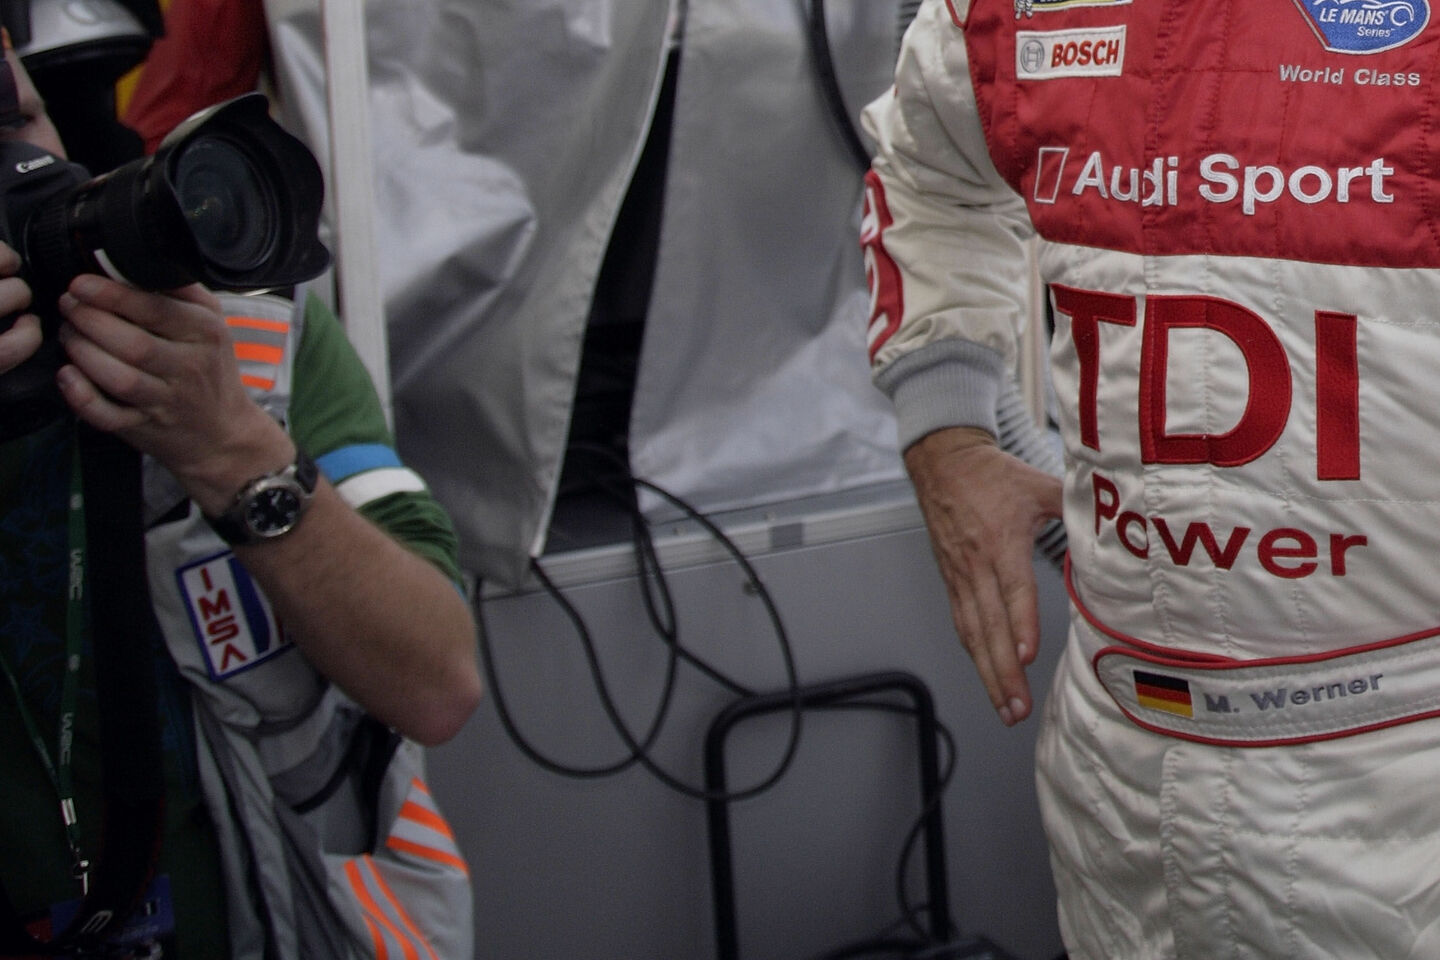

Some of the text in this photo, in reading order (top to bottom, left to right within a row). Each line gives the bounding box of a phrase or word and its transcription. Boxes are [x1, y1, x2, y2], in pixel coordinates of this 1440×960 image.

[1320, 8, 1386, 25] LE MANS
[1357, 26, 1391, 38] Series
[1051, 39, 1120, 68] BOSCH
[1279, 64, 1420, 86] World Class
[1072, 151, 1395, 216] Audi Sport
[1053, 283, 1361, 481] TDI
[1092, 472, 1369, 580] Power
[197, 566, 248, 672] IMSA
[1203, 673, 1384, 714] M. Werner
